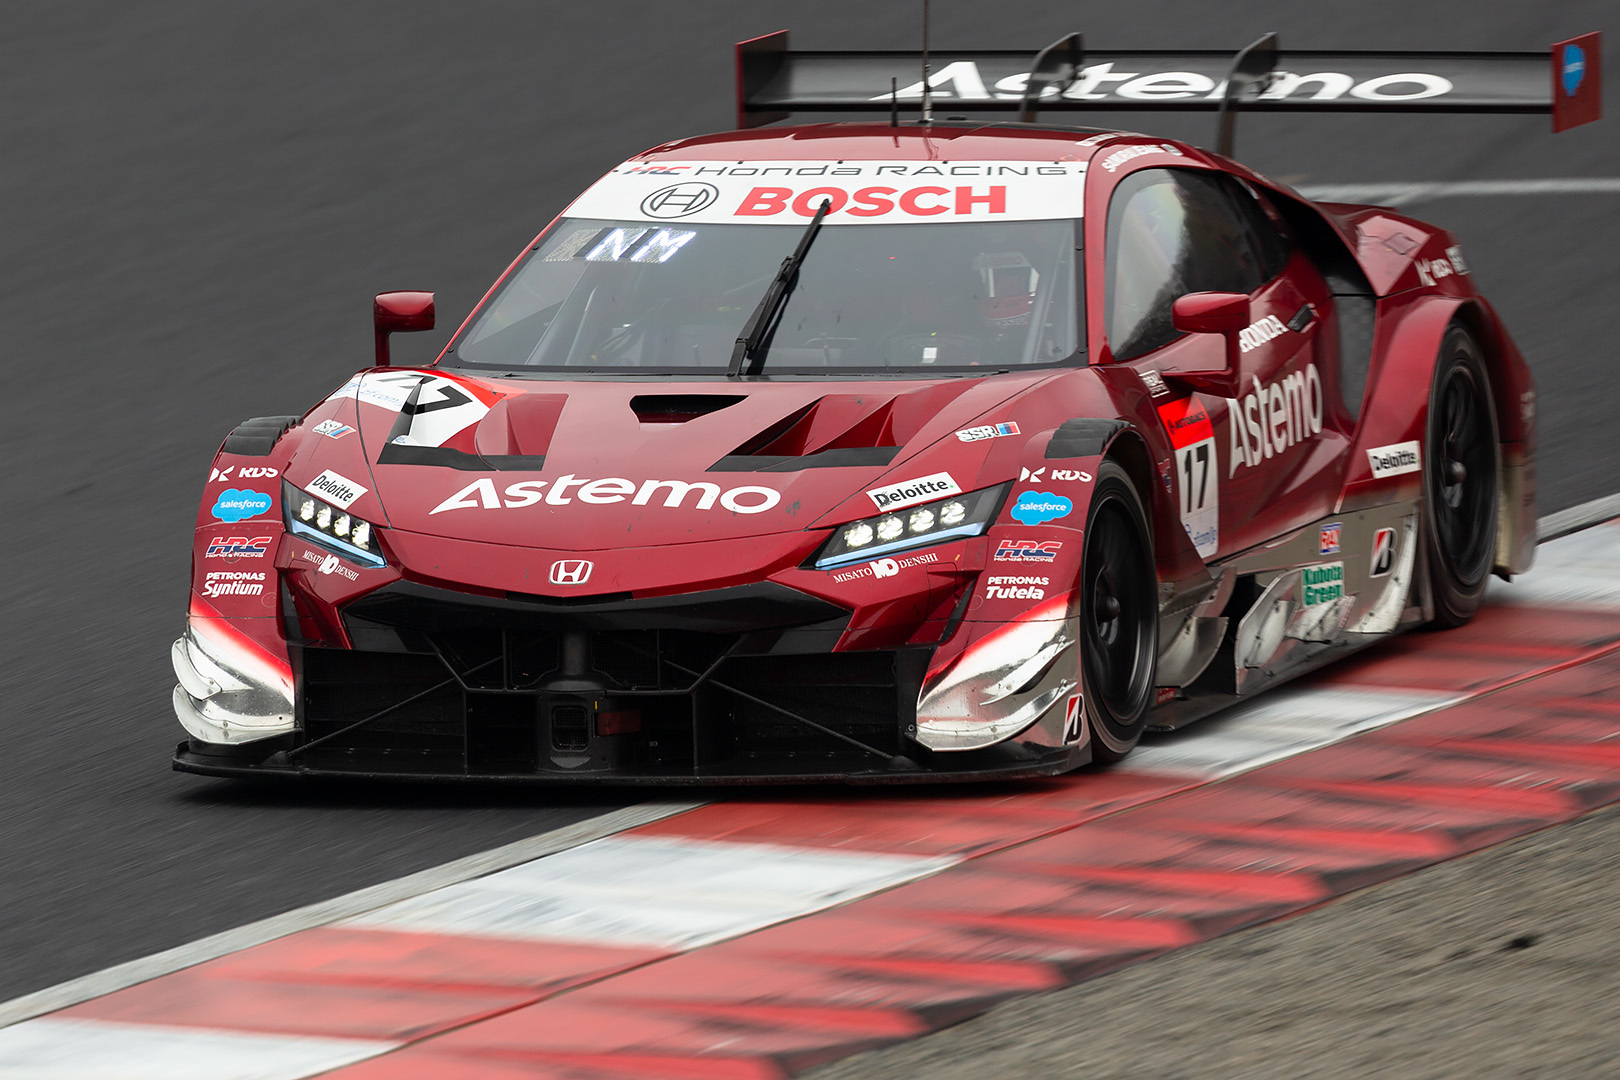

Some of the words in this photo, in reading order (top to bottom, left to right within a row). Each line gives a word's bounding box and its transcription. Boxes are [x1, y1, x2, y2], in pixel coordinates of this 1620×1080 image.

[868, 61, 1454, 101] Astemo
[694, 164, 862, 176] Honda
[876, 165, 1067, 176] RACING
[733, 185, 1007, 218] BOSCH
[1225, 362, 1323, 480] Astemo
[1183, 443, 1209, 514] 17
[428, 473, 782, 515] Astemo
[220, 500, 266, 509] salesforce
[1019, 502, 1067, 512] salesforce
[206, 571, 266, 581] PETRONAS
[833, 566, 873, 584] MISATO
[899, 553, 939, 570] DENSHI
[201, 580, 264, 598] Syntium
[987, 576, 1050, 586] PETRONAS
[985, 586, 1045, 600] Tutela
